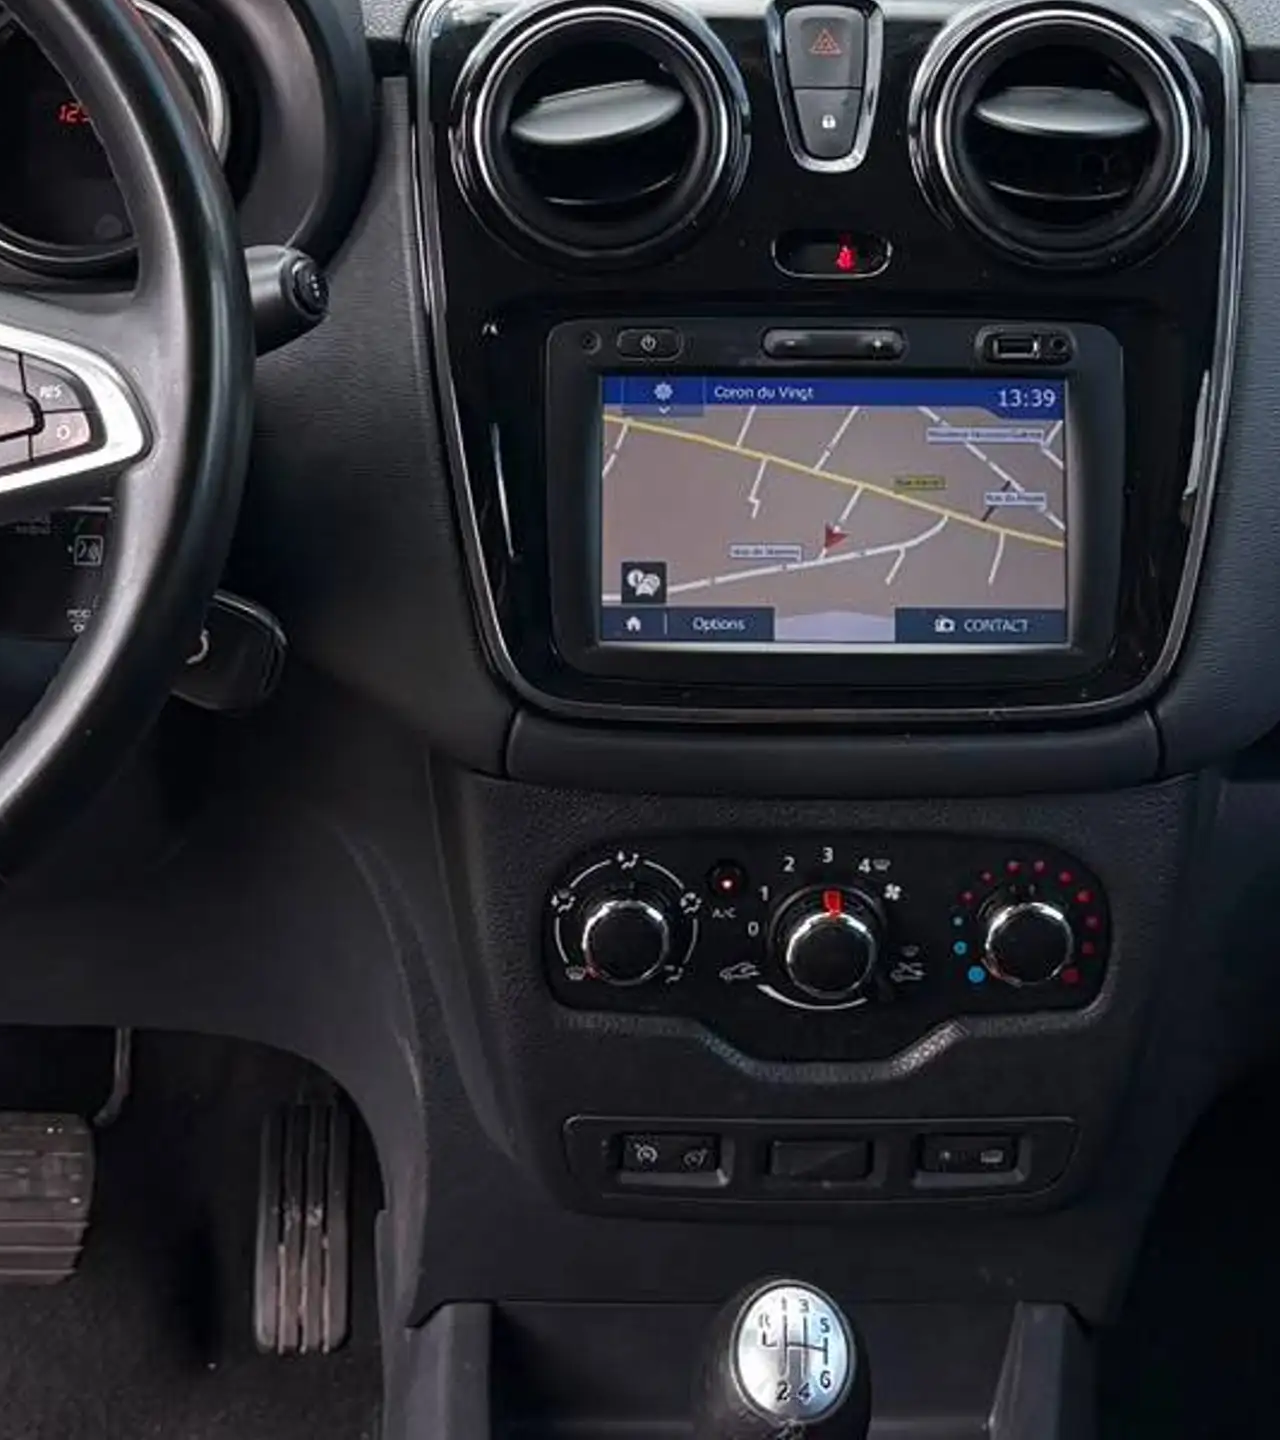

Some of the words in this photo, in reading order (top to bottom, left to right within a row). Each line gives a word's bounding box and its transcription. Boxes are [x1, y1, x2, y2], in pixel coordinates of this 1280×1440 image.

[713, 385, 754, 400] Coron
[757, 385, 776, 400] du
[997, 388, 1057, 408] 13:39
[692, 616, 746, 634] Options
[963, 618, 1029, 633] CONTACT
[822, 846, 834, 863] 3
[783, 856, 795, 872] 2
[858, 858, 871, 873] 4
[759, 885, 769, 901] 1
[747, 921, 759, 937] 0
[798, 1298, 810, 1313] 3
[819, 1317, 831, 1333] 5
[819, 1370, 832, 1389] 6
[776, 1380, 791, 1401] 2
[797, 1382, 811, 1400] 4
